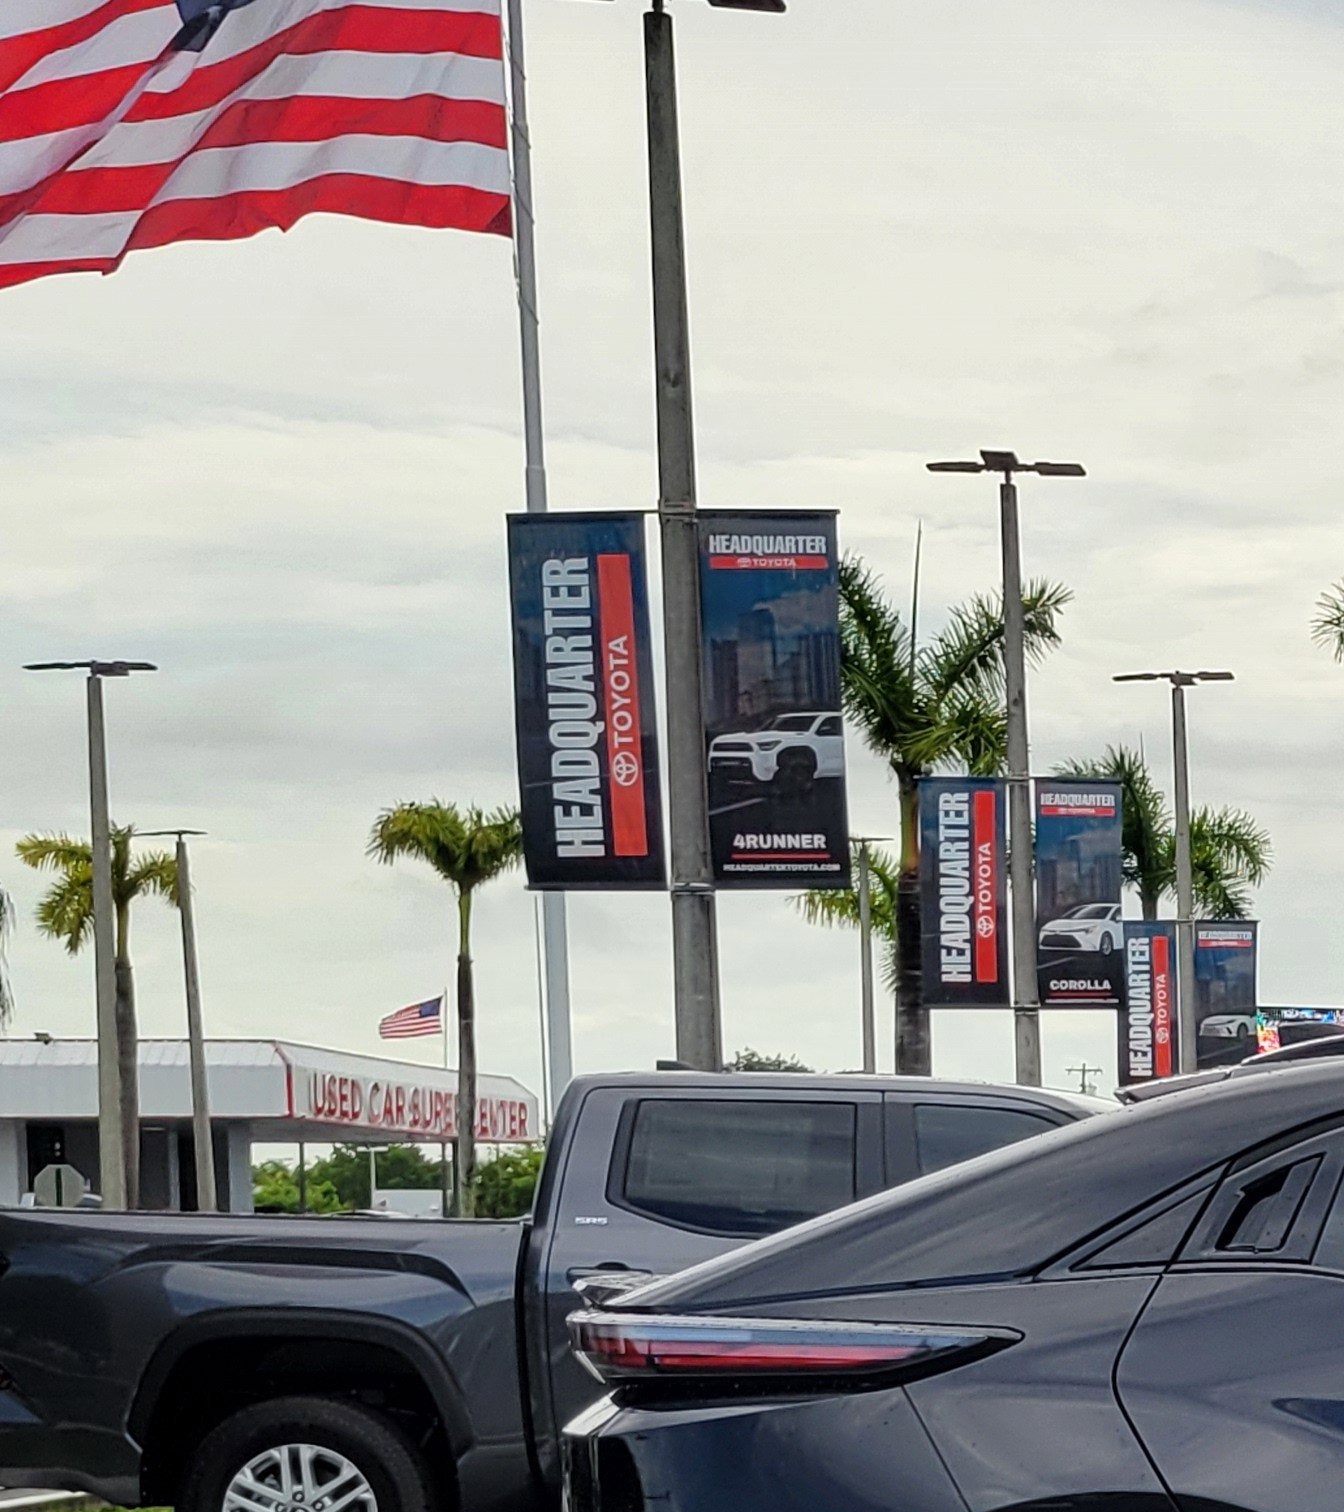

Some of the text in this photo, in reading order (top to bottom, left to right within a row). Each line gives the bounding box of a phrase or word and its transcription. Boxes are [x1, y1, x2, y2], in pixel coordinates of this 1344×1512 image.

[709, 534, 827, 556] HEADQUARTER
[752, 558, 797, 567] TOYOTA
[541, 556, 606, 858] HEADQUARTER
[609, 634, 634, 746] TOYOTA
[733, 833, 827, 849] 4RUNNER
[939, 792, 974, 983] HEADQUARTER
[976, 842, 992, 914] TOYOTA
[1049, 979, 1112, 991] COROLLA
[1127, 937, 1155, 1077] HEADQUARTER
[1156, 974, 1167, 1026] TOYOTA
[311, 1071, 363, 1120] USED
[368, 1081, 406, 1126] CAR
